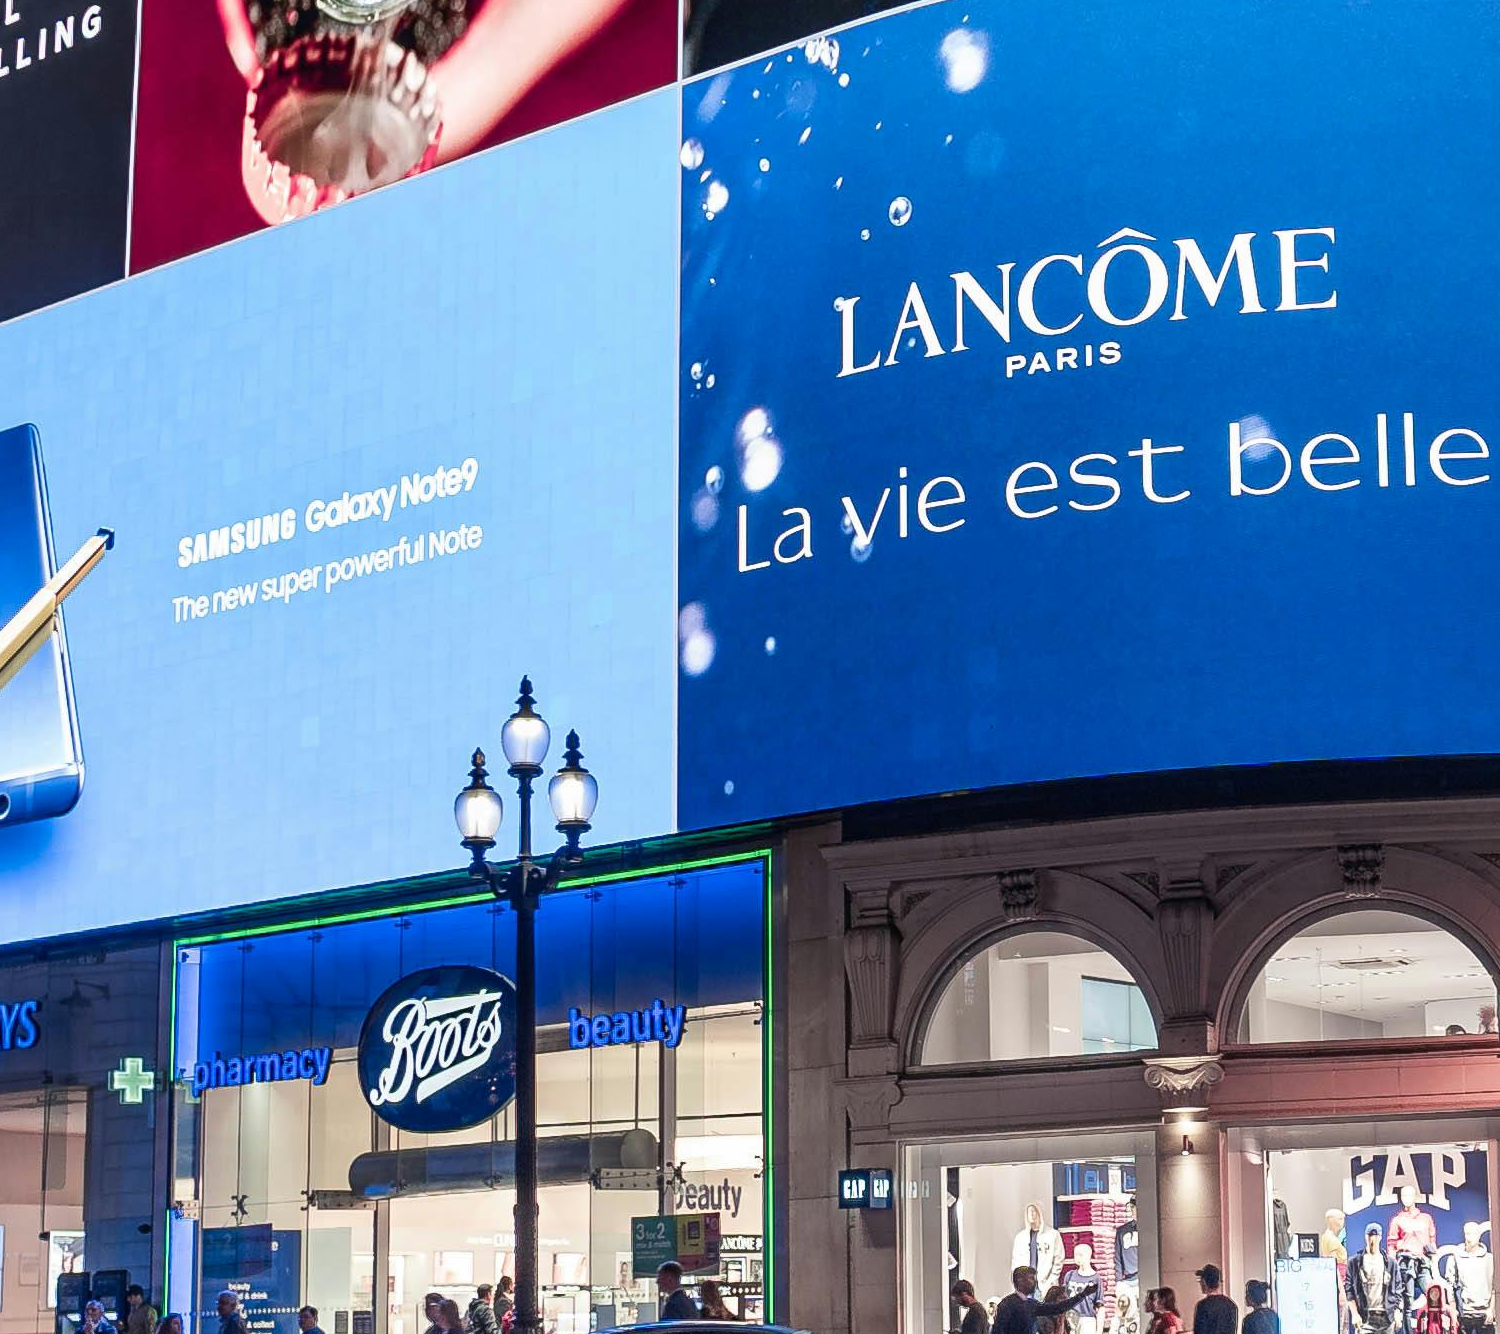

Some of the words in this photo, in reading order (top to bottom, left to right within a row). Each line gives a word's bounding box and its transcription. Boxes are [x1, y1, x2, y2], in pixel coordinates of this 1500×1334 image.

[835, 226, 1339, 379] LANCÔME
[1005, 338, 1123, 380] PARIS
[176, 506, 297, 569] SAMSUNG
[304, 482, 398, 534] Galaxy
[399, 455, 481, 511] Note9
[735, 500, 814, 574] La
[840, 465, 967, 541] vie
[1004, 435, 1192, 522] est
[1228, 411, 1492, 499] belle
[171, 591, 211, 625] The
[211, 582, 259, 616] new
[260, 564, 323, 606] super
[324, 531, 426, 595] powerful
[428, 520, 484, 559] Note
[369, 988, 503, 1108] Boots
[567, 997, 687, 1051] beauty
[192, 1045, 334, 1098] pharmacy
[841, 1178, 867, 1201] GAP
[1343, 1151, 1467, 1217] GAP
[635, 1223, 646, 1241] 3
[656, 1222, 666, 1240] 2
[719, 1235, 756, 1251] ANCÔME
[1276, 1259, 1303, 1273] BIG
